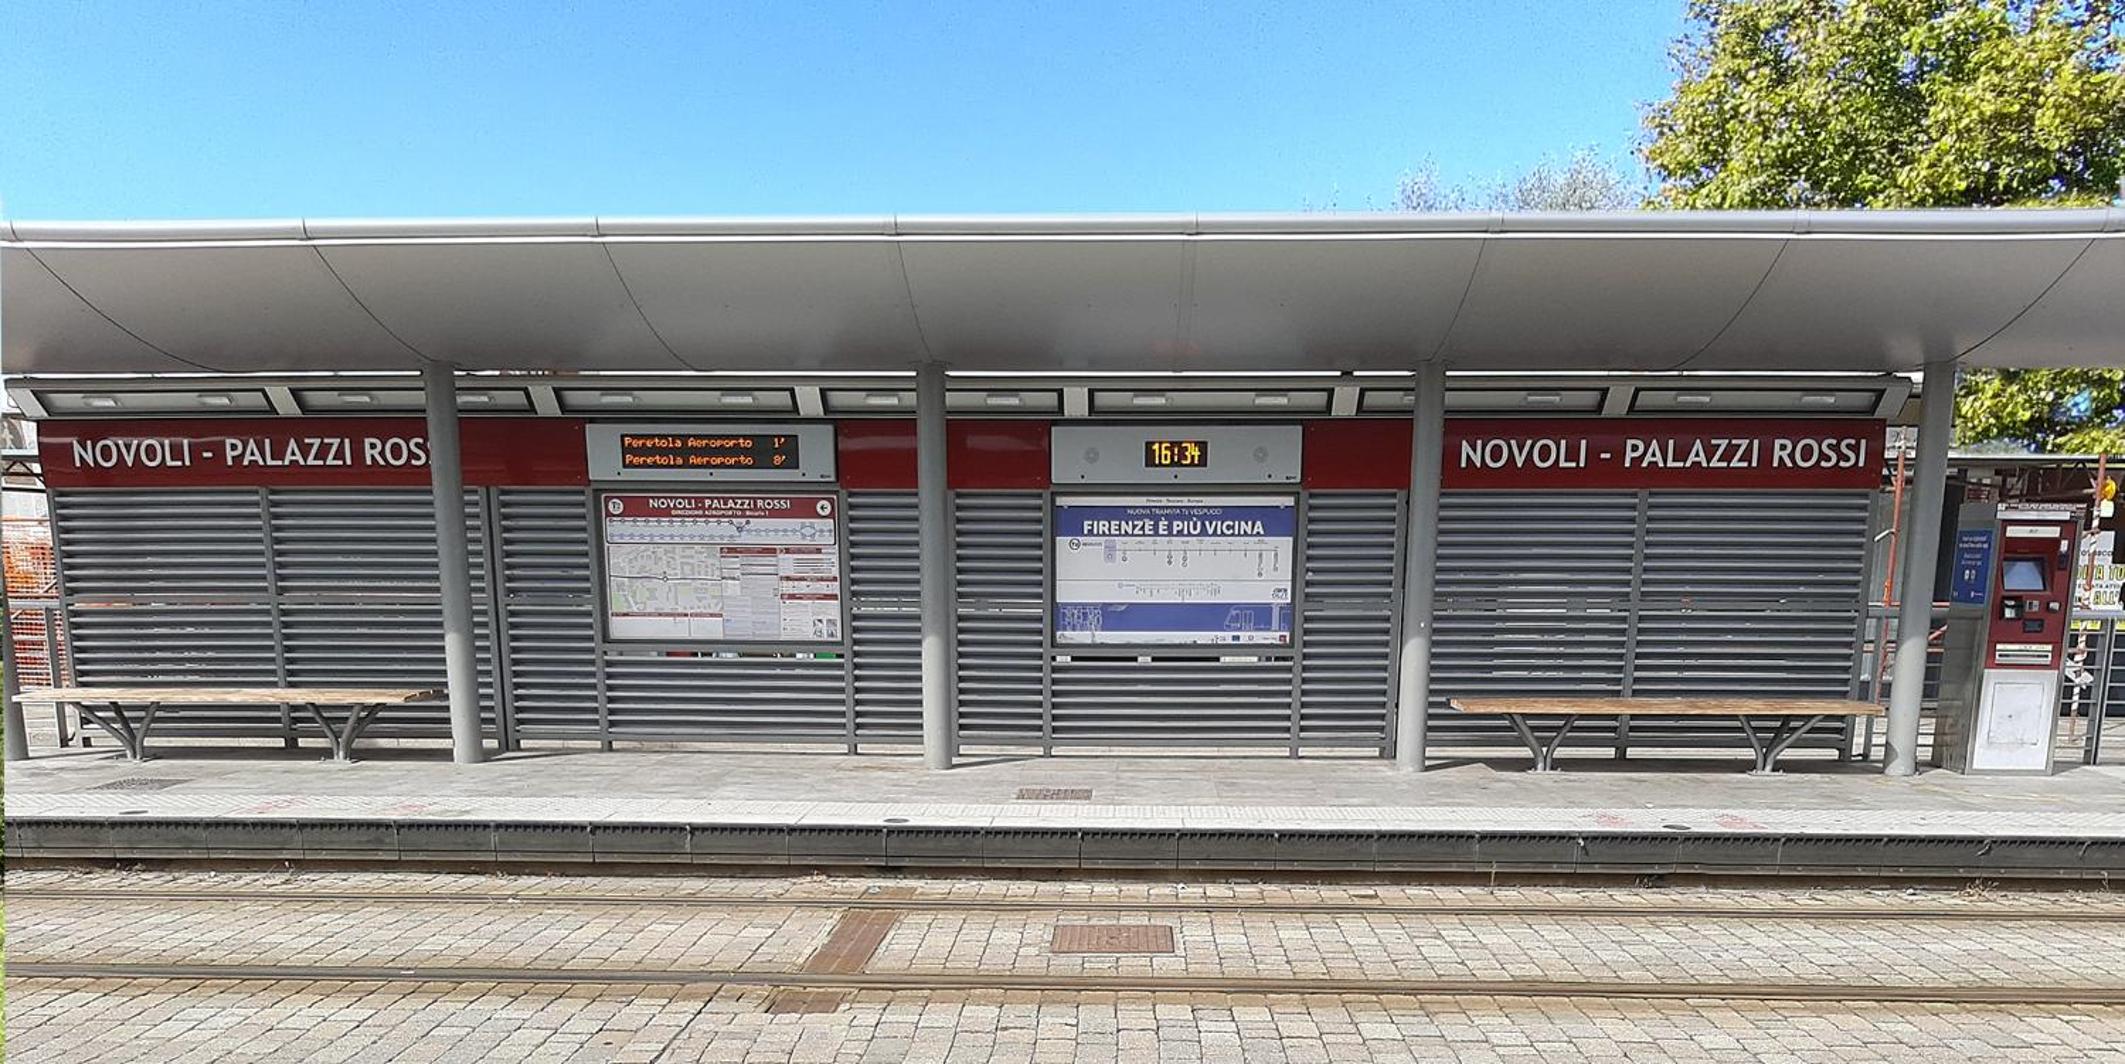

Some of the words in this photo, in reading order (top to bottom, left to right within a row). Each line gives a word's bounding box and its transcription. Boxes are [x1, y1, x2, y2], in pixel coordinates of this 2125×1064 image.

[624, 437, 682, 448] Peretola
[688, 437, 752, 449] Aeroporto
[72, 438, 191, 467] NOVOLI
[202, 451, 213, 459] -
[224, 437, 353, 467] PALAZZI
[364, 437, 431, 466] ROS
[625, 454, 683, 466] Peretola
[689, 454, 754, 466] Aeroporto
[1152, 441, 1201, 465] 16:34
[1460, 438, 1588, 468] NOVOLI
[1600, 450, 1611, 460] -
[1624, 438, 1759, 467] PALAZZI
[1772, 438, 1867, 468] ROSSI
[649, 498, 695, 509] NOVOLI
[704, 499, 754, 509] PALAZZI
[757, 499, 790, 509] ROSSI
[1083, 520, 1154, 534] FIRENZE
[1158, 517, 1168, 534] È
[1173, 517, 1200, 534] PIÙ
[1206, 521, 1264, 534] VICINA
